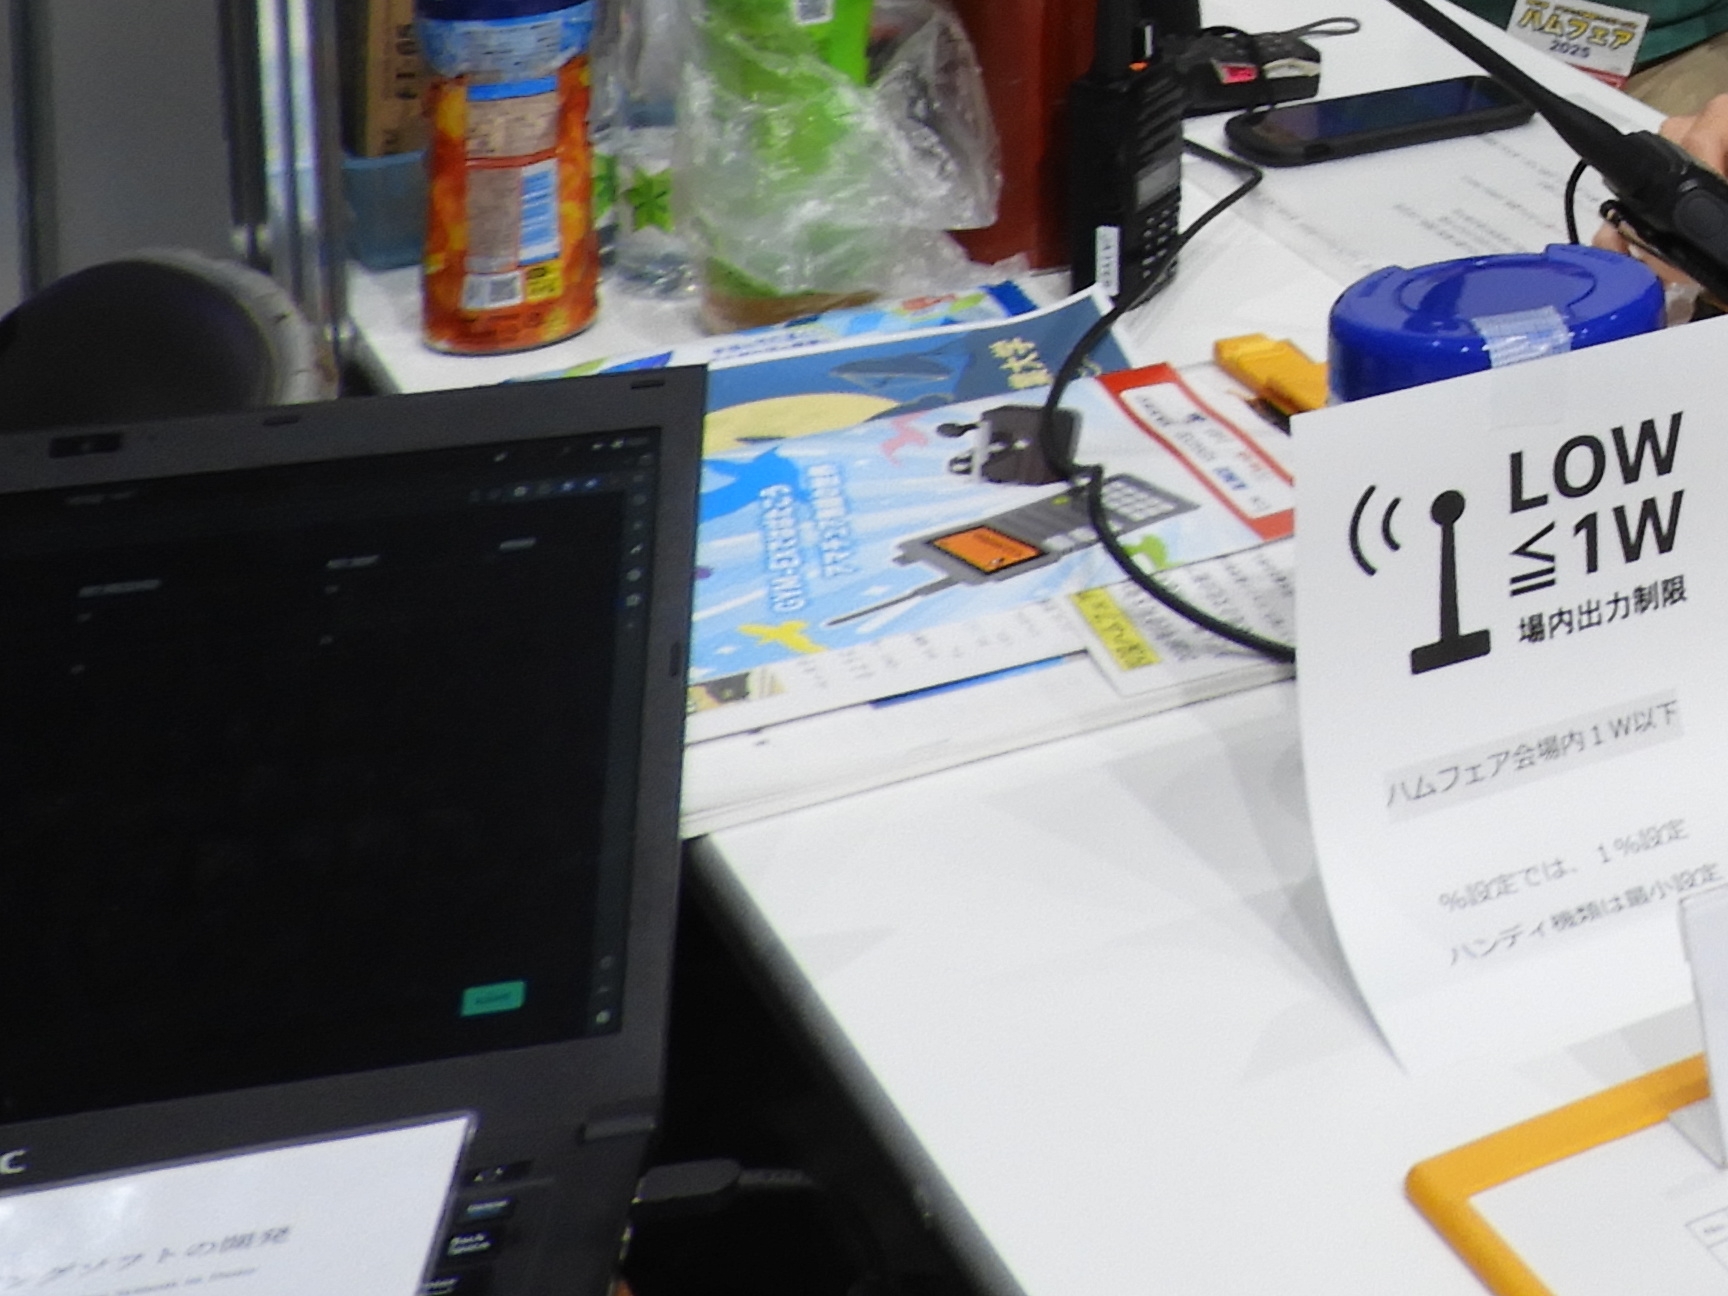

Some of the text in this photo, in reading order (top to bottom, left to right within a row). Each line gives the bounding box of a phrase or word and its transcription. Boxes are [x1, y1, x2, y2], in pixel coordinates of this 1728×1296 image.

[1517, 7, 1636, 52] ハムフェア
[1549, 38, 1591, 59] 2025
[1508, 410, 1687, 515] LOW
[1517, 575, 1691, 646] 場内出力制限
